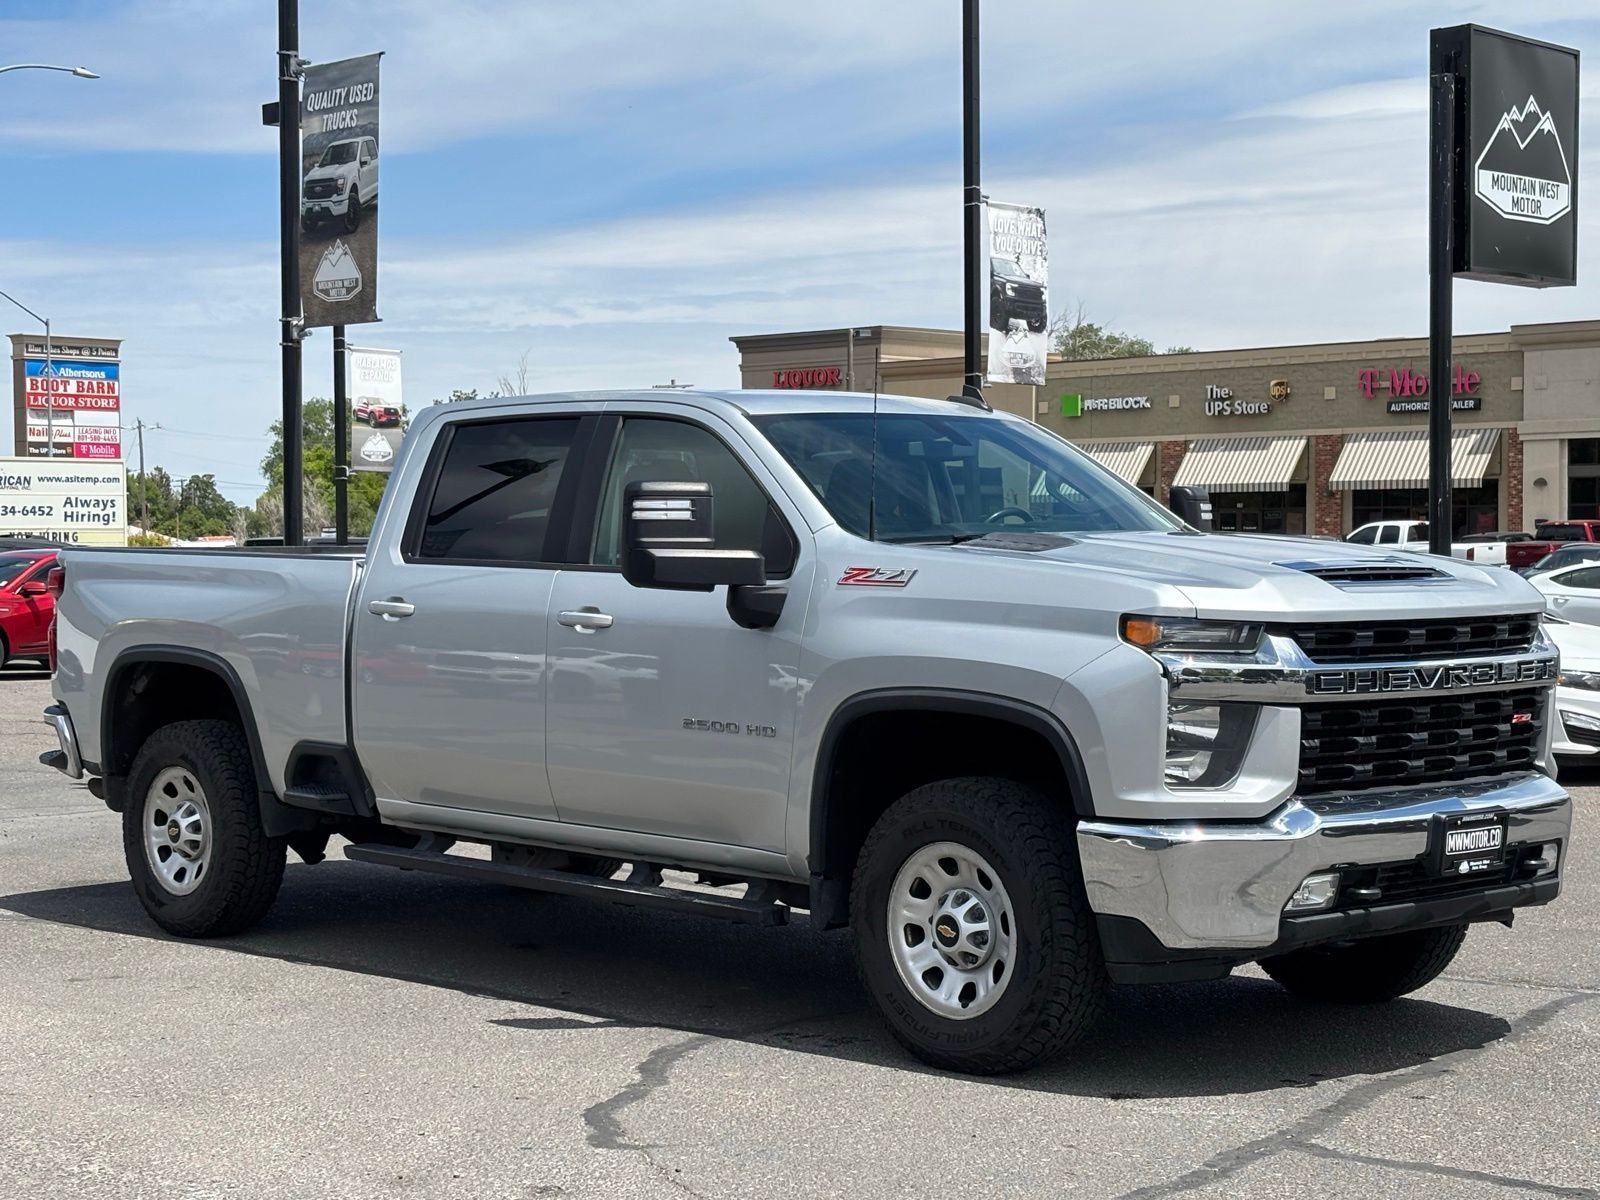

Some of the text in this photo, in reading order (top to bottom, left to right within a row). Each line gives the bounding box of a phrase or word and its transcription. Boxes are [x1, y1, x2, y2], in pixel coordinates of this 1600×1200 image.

[307, 82, 374, 112] QUALITY USED
[322, 108, 358, 133] TRUCKS
[1491, 173, 1560, 201] MOUNTAIN WEST
[1511, 195, 1542, 215] MOTOR
[994, 218, 1043, 238] LOVE WHAT
[995, 234, 1043, 256] YOU DRIVE
[43, 345, 61, 354] Lkes
[62, 346, 80, 356] Shops
[59, 367, 106, 379] Albertsons
[772, 366, 840, 389] LIQUOR
[30, 378, 116, 395] BOOT BARN
[1205, 384, 1230, 399] The
[29, 395, 117, 409] LIQUOR STORE
[1109, 396, 1151, 410] BLOCK
[1205, 400, 1269, 416] UPS Store
[1390, 402, 1430, 412] AUTHORIZ
[28, 427, 54, 438] Nail
[78, 427, 117, 436] LEASING INFO
[37, 475, 120, 486] www.asitemp.com
[0, 505, 54, 517] 34-6452
[63, 497, 116, 511] Always
[63, 511, 116, 526] Hiring!
[837, 566, 918, 588] Z71
[1313, 658, 1556, 694] CHEVROLET
[682, 718, 777, 738] 2500 HD
[1448, 828, 1501, 852] MWMOTOR.CO
